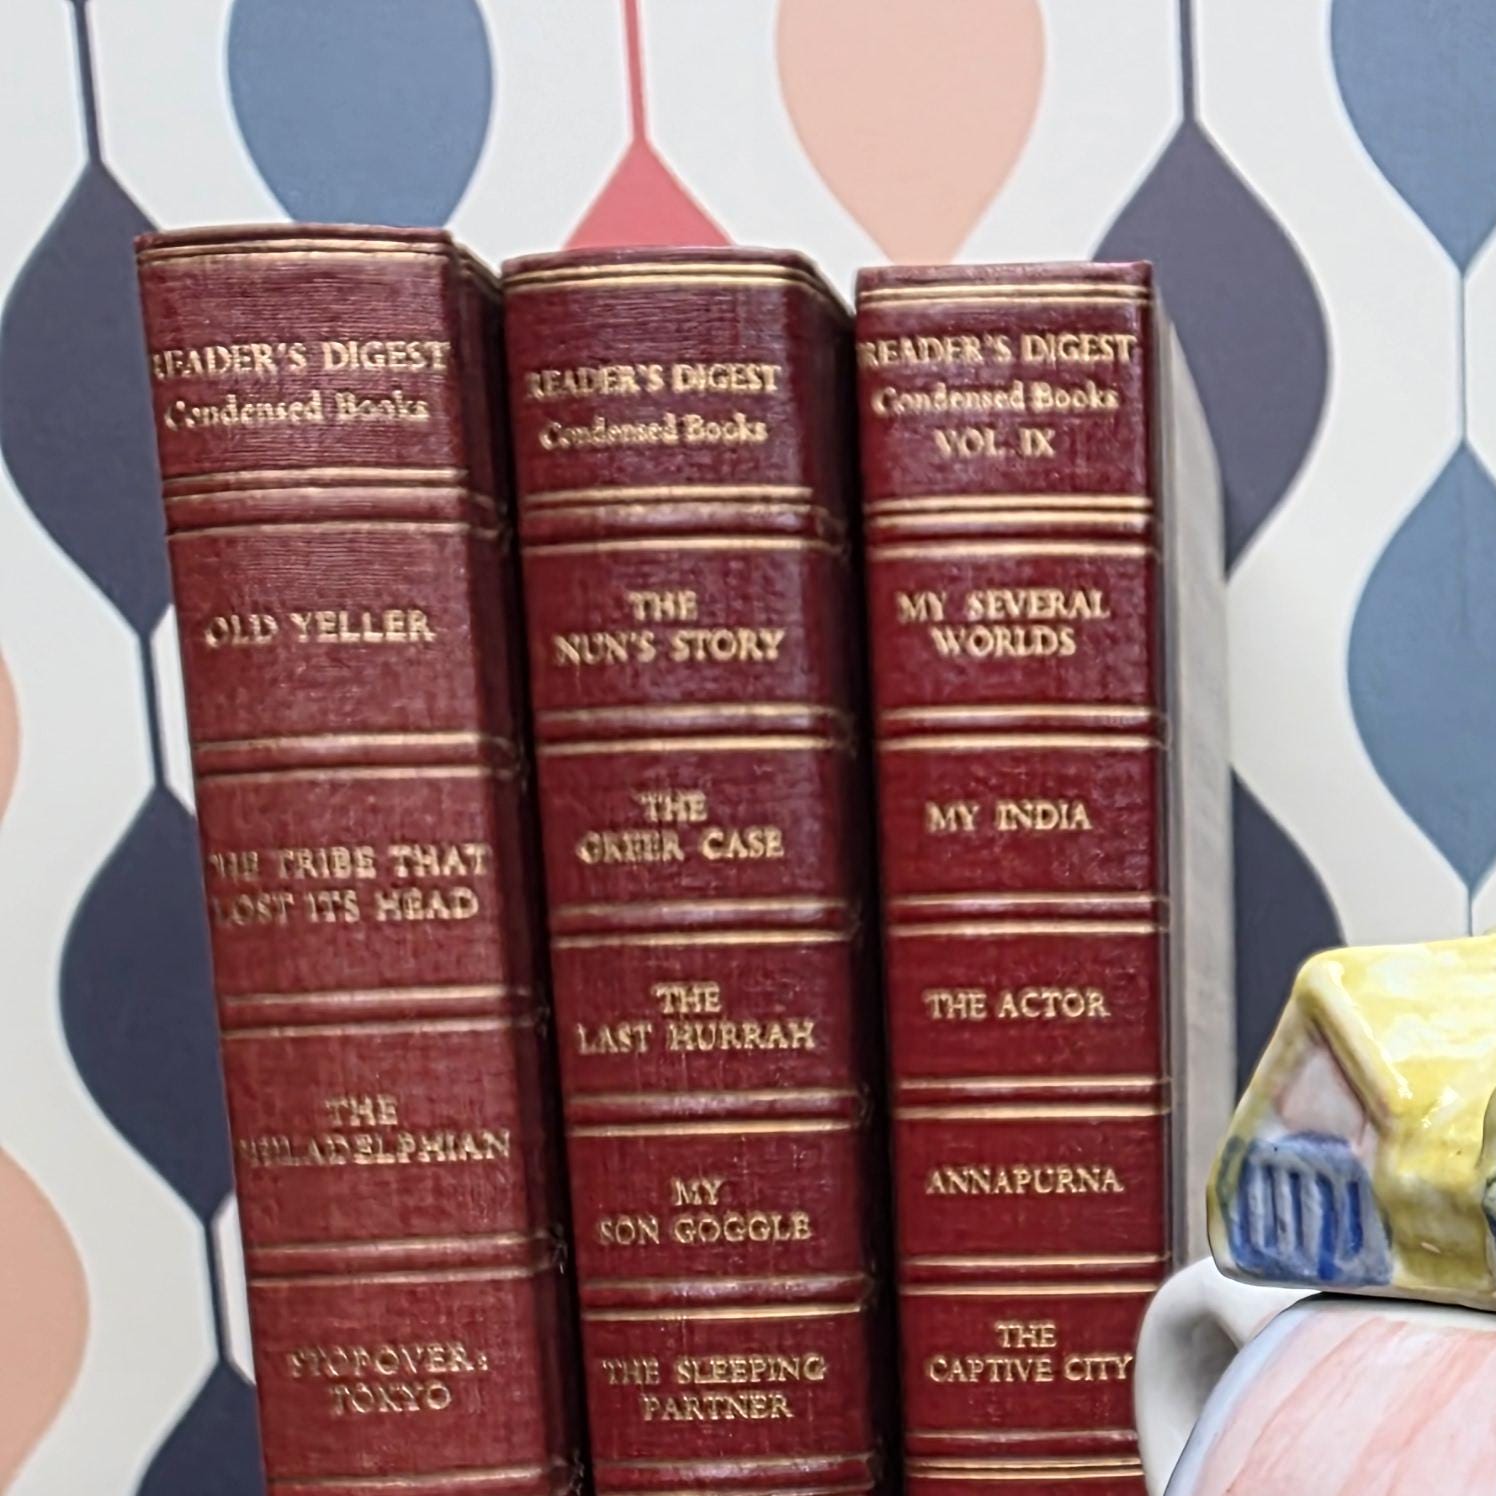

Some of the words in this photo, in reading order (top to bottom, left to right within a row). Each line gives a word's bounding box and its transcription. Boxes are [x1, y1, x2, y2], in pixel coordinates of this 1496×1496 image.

[321, 341, 451, 373] DIGEST
[856, 334, 1011, 369] READER'S
[1021, 333, 1138, 364] DIGEST
[671, 363, 783, 394] DIGEST
[164, 390, 325, 431] Condensed
[335, 389, 431, 422] Books
[871, 379, 1025, 418] Condensed
[1029, 379, 1120, 414] Books
[539, 411, 679, 450] Condensed
[684, 411, 769, 446] Books
[1019, 427, 1056, 458] IX
[628, 590, 698, 622] THE
[898, 590, 947, 624] MY
[966, 588, 1111, 622] SEVERAL
[205, 613, 278, 648] OLD
[289, 609, 437, 644] YELLER
[929, 625, 1077, 659] WORLDS
[553, 629, 656, 666] NUN'S
[669, 627, 786, 662] STORY
[636, 789, 708, 824] THE
[925, 801, 980, 833] MY
[996, 801, 1093, 831] INDIA
[699, 825, 785, 860] CASE
[277, 845, 377, 881] TRIBE
[387, 842, 493, 879] THAT
[304, 888, 361, 923] ITS
[374, 885, 480, 922] HEAD
[653, 982, 723, 1016] THE
[924, 988, 988, 1020] THE
[997, 987, 1112, 1019] ACTOR
[578, 1021, 653, 1055] LAST
[668, 1017, 816, 1052] HURRAH
[325, 1093, 399, 1127] THE
[671, 1177, 724, 1207] MY
[926, 1163, 1125, 1196] ANNAPURNA
[599, 1213, 661, 1246] SON
[673, 1210, 813, 1245] GOGGLE
[995, 1320, 1058, 1350] THE
[601, 1358, 661, 1387] THE
[674, 1352, 828, 1385] SLEEPING
[927, 1355, 1054, 1384] CAPTIVE
[1063, 1353, 1135, 1382] CITY
[328, 1379, 452, 1416] TOKYO
[641, 1392, 795, 1422] PARTNER
